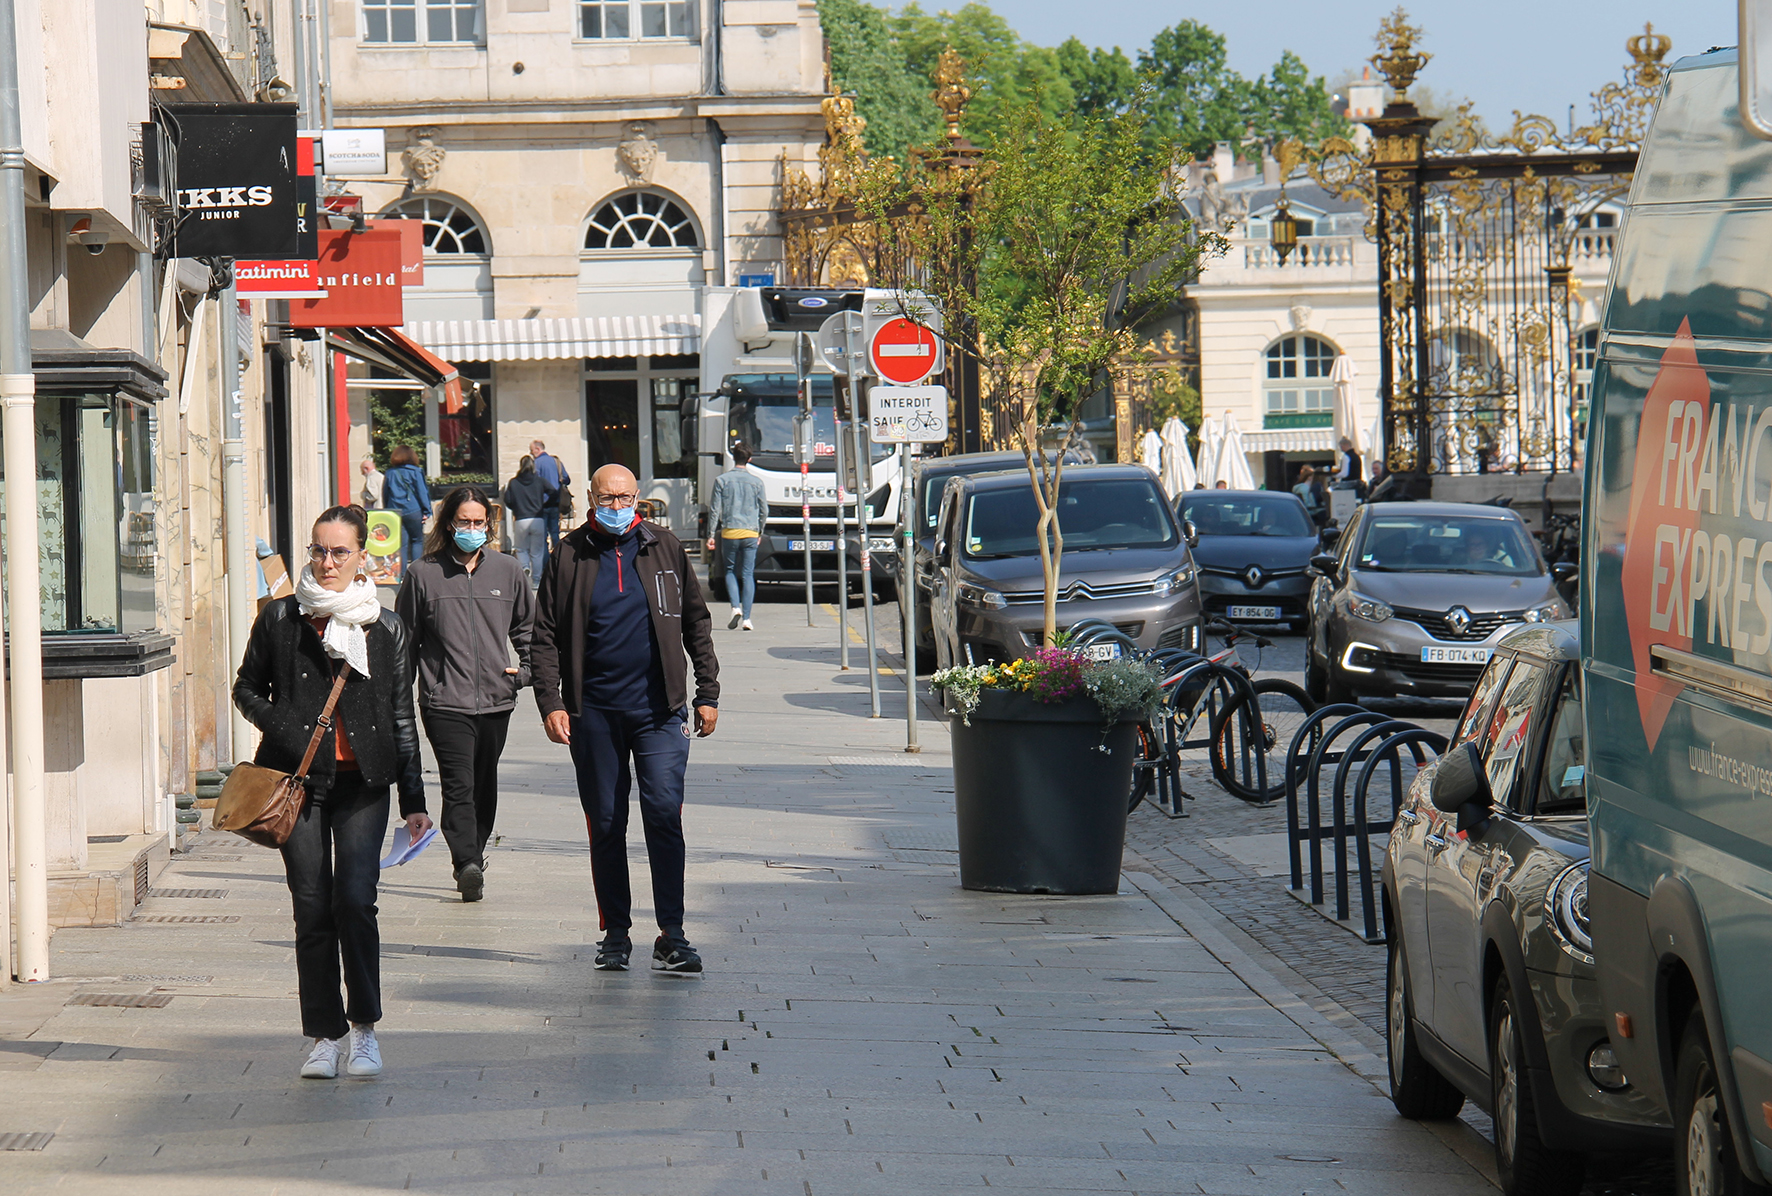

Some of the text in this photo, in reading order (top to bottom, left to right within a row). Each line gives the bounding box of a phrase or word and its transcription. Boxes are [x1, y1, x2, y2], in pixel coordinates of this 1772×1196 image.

[176, 185, 273, 209] IKKS
[200, 210, 240, 220] JUNIOR
[235, 263, 310, 281] catimini
[316, 273, 396, 287] anfield
[880, 398, 931, 408] INTERDIT
[874, 416, 903, 426] SAUF
[1658, 399, 1772, 522] FRANC
[1430, 648, 1486, 662] FB-074-KQ
